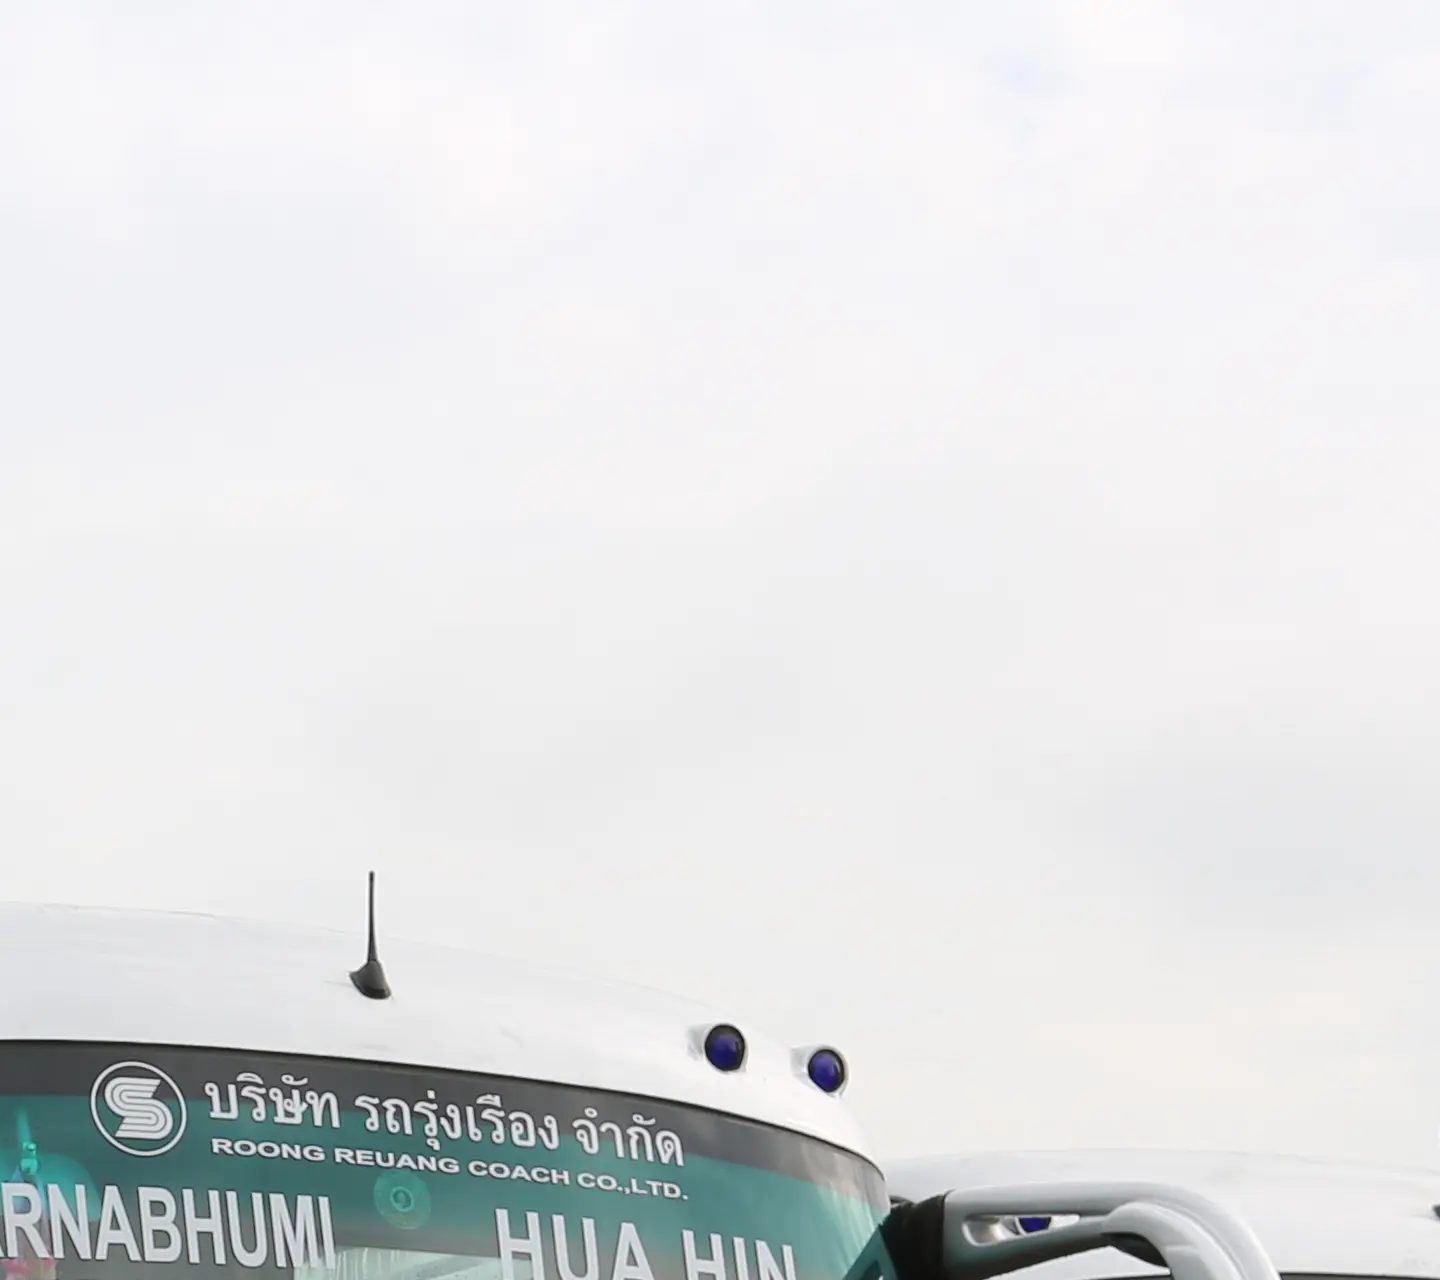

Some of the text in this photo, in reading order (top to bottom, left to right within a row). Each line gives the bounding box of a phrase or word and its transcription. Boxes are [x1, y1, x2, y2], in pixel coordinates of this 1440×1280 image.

[205, 1073, 684, 1168] บริษัท รถรุ่งเรือง จำกัด
[211, 1138, 688, 1200] ROONG REUANG COACH CO.,LTD.
